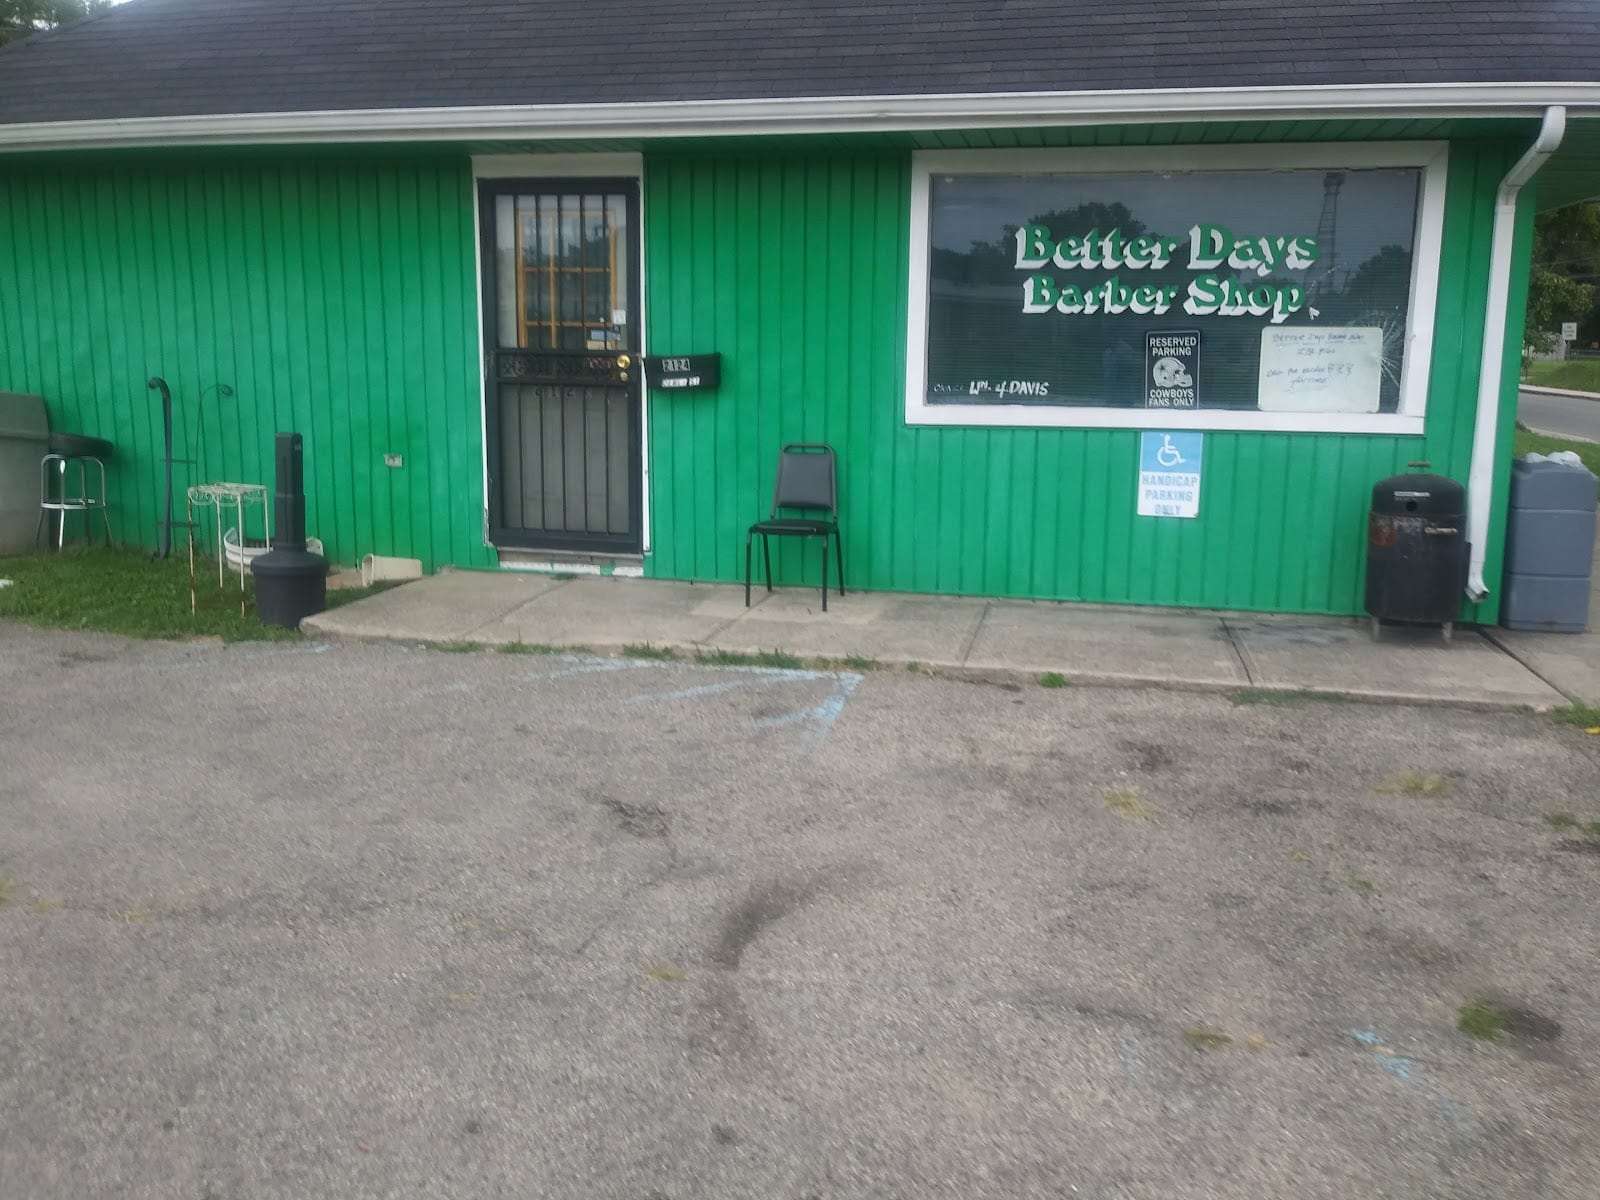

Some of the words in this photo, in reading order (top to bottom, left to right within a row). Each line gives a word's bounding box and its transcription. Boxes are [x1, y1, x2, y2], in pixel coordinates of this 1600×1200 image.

[1014, 223, 1180, 270] Better
[1187, 223, 1320, 277] Days
[1022, 274, 1180, 315] Barber
[1183, 273, 1306, 324] Shop
[1149, 336, 1197, 347] RESERVED
[1152, 347, 1192, 357] PARKING
[1009, 380, 1049, 395] DAVIS
[1149, 388, 1194, 399] COWBOYS
[1148, 398, 1169, 407] FANS
[1173, 397, 1195, 407] ONLY
[1142, 474, 1198, 488] HANDICAP
[1145, 488, 1193, 502] PARKING
[1154, 504, 1181, 515] ONLY
